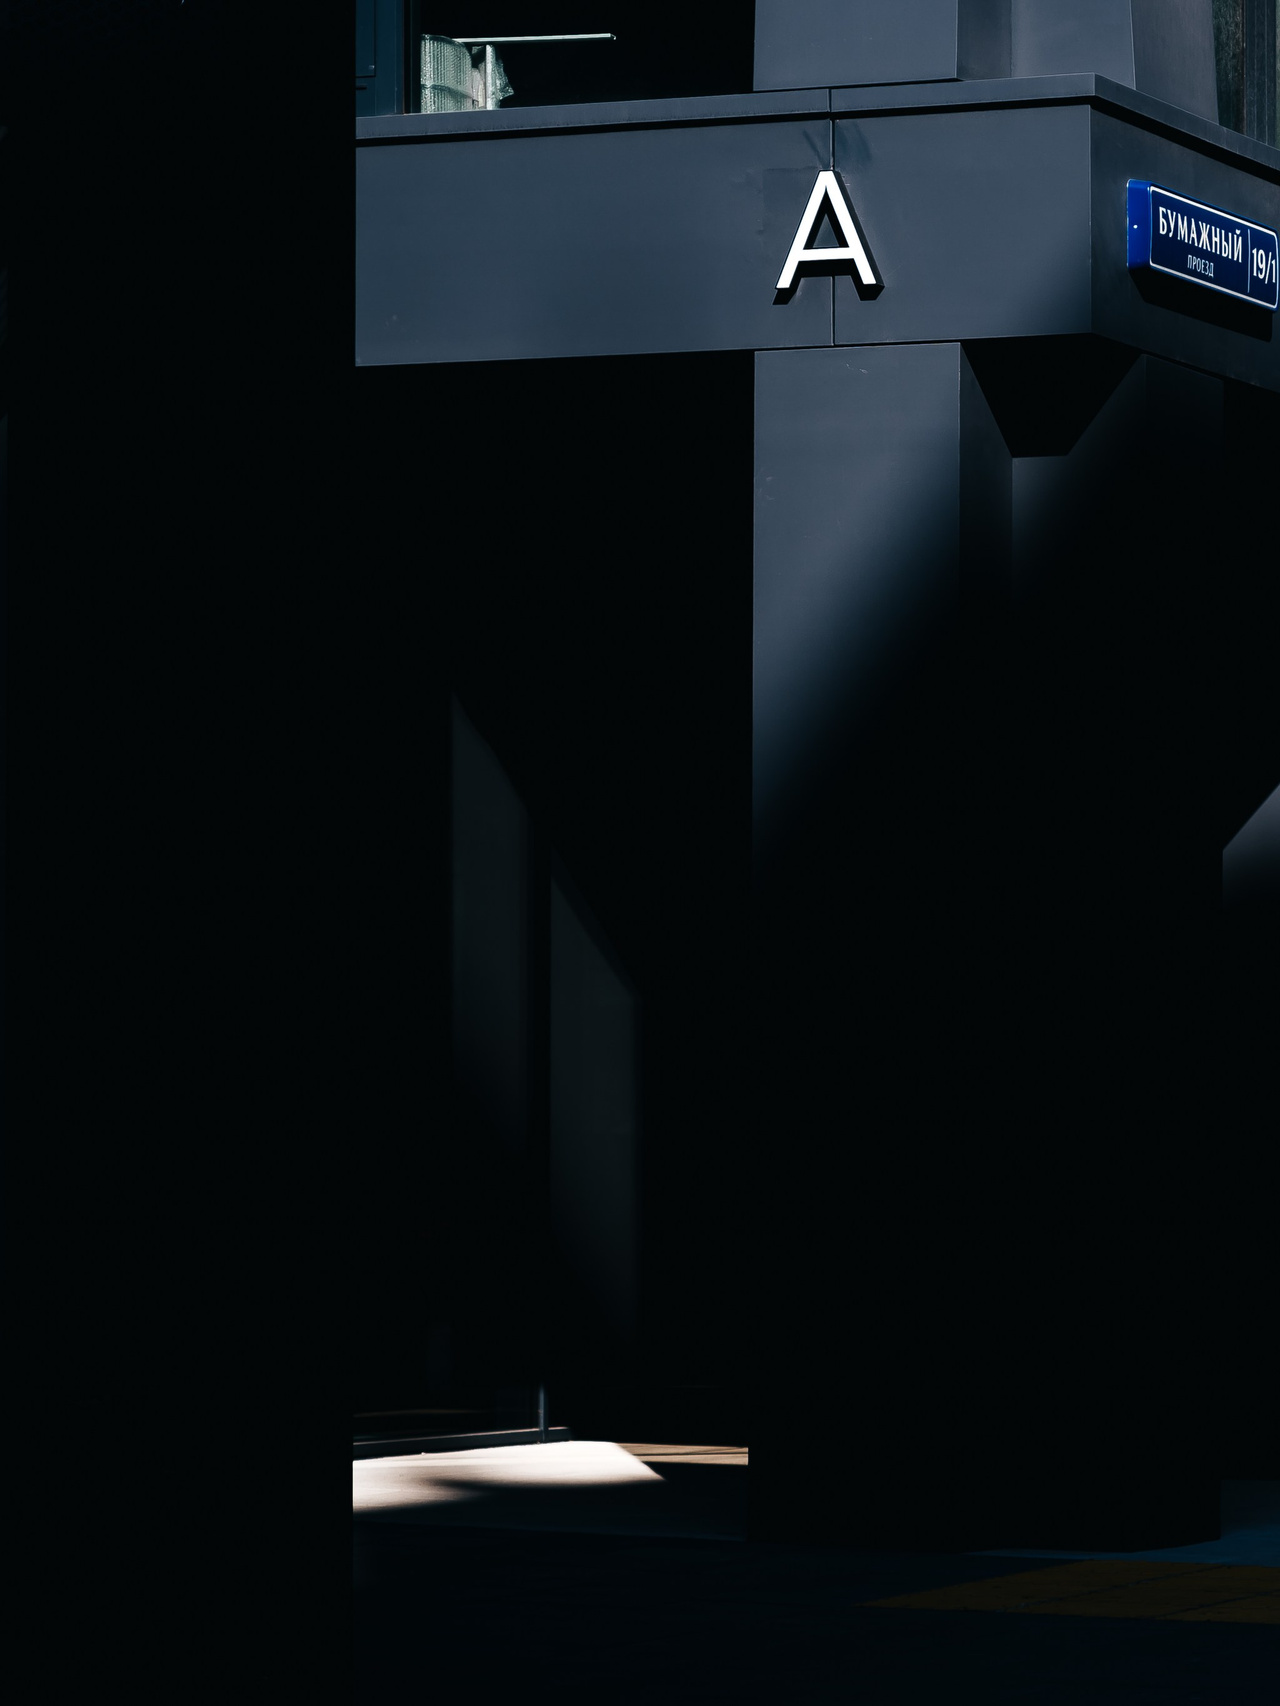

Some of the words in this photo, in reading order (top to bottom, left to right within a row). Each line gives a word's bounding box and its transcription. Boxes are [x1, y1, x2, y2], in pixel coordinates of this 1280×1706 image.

[1159, 206, 1242, 263] БУМАЖНЫЙ
[1187, 254, 1214, 278] ПРОЕЗД
[1252, 249, 1276, 284] 19/1
